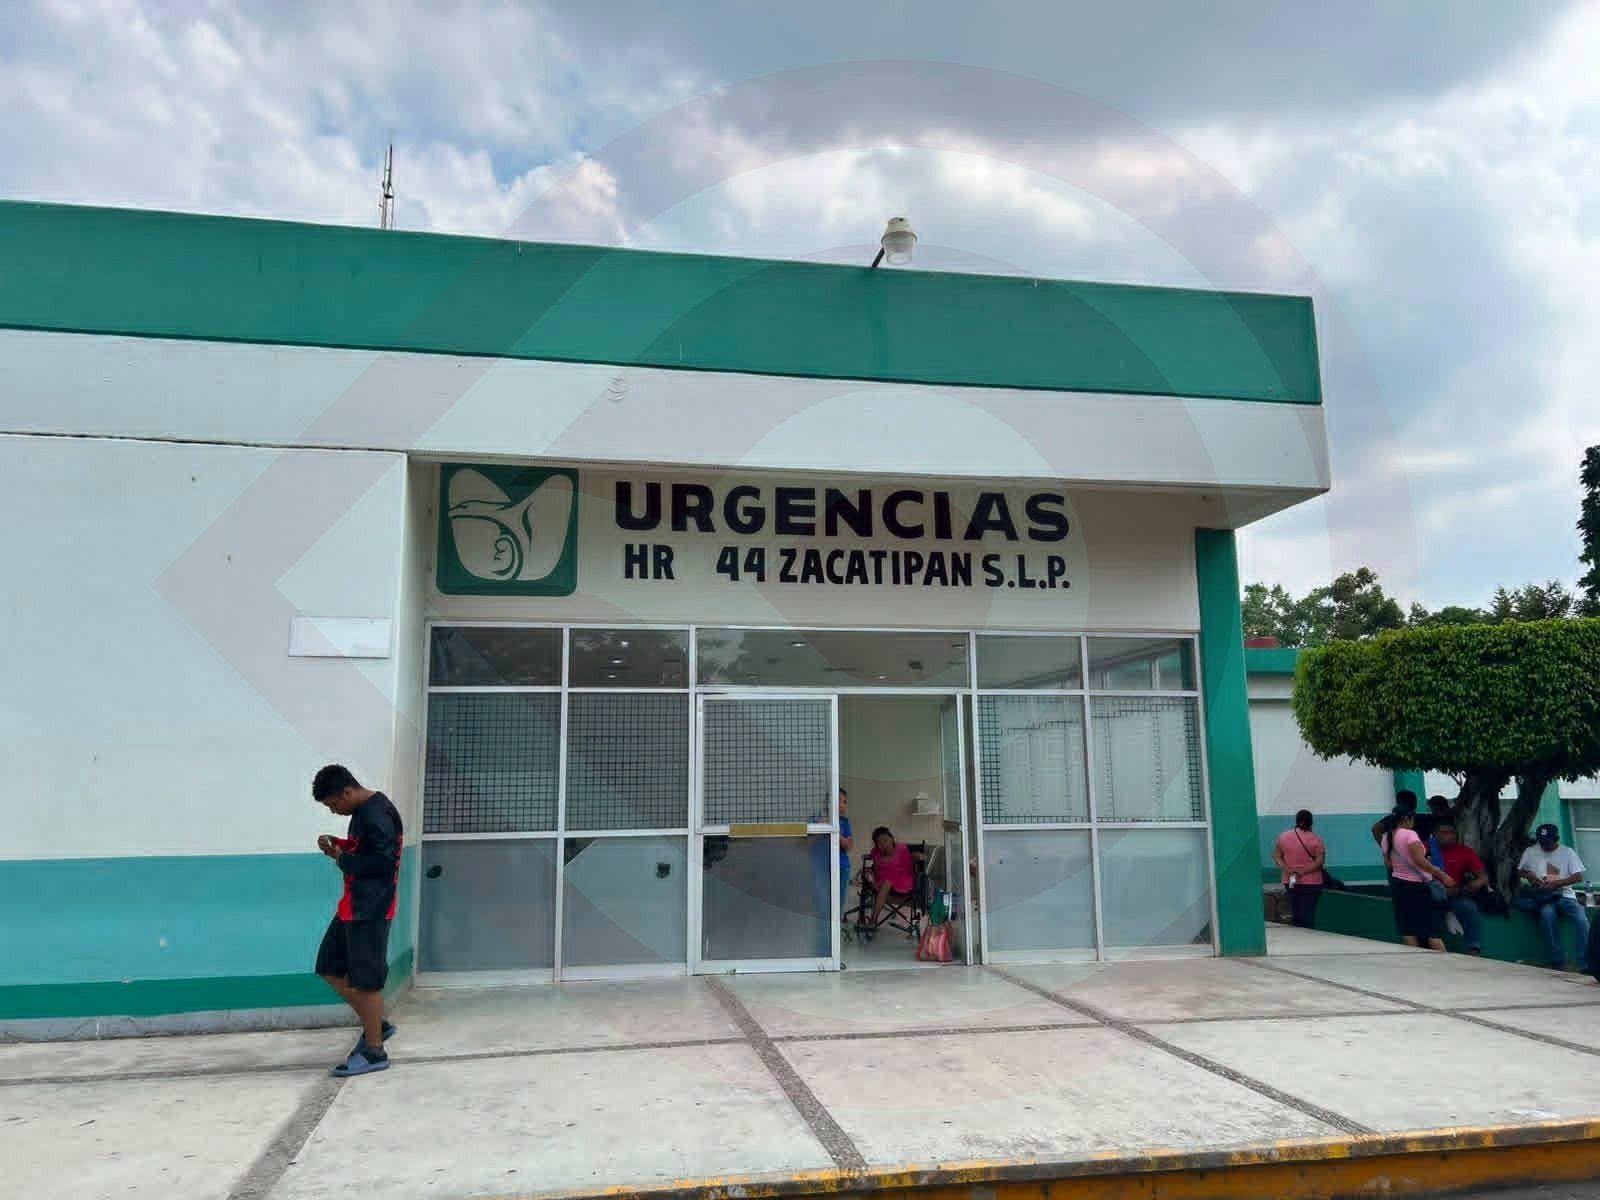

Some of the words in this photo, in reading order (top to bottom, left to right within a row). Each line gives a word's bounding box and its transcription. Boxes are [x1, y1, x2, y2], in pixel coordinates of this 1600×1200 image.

[614, 480, 1070, 543] URGENCIAS
[624, 543, 675, 581] HR
[715, 545, 766, 583] 44
[778, 547, 973, 587] ZACATIPAN
[981, 553, 1071, 590] S.L.P.
